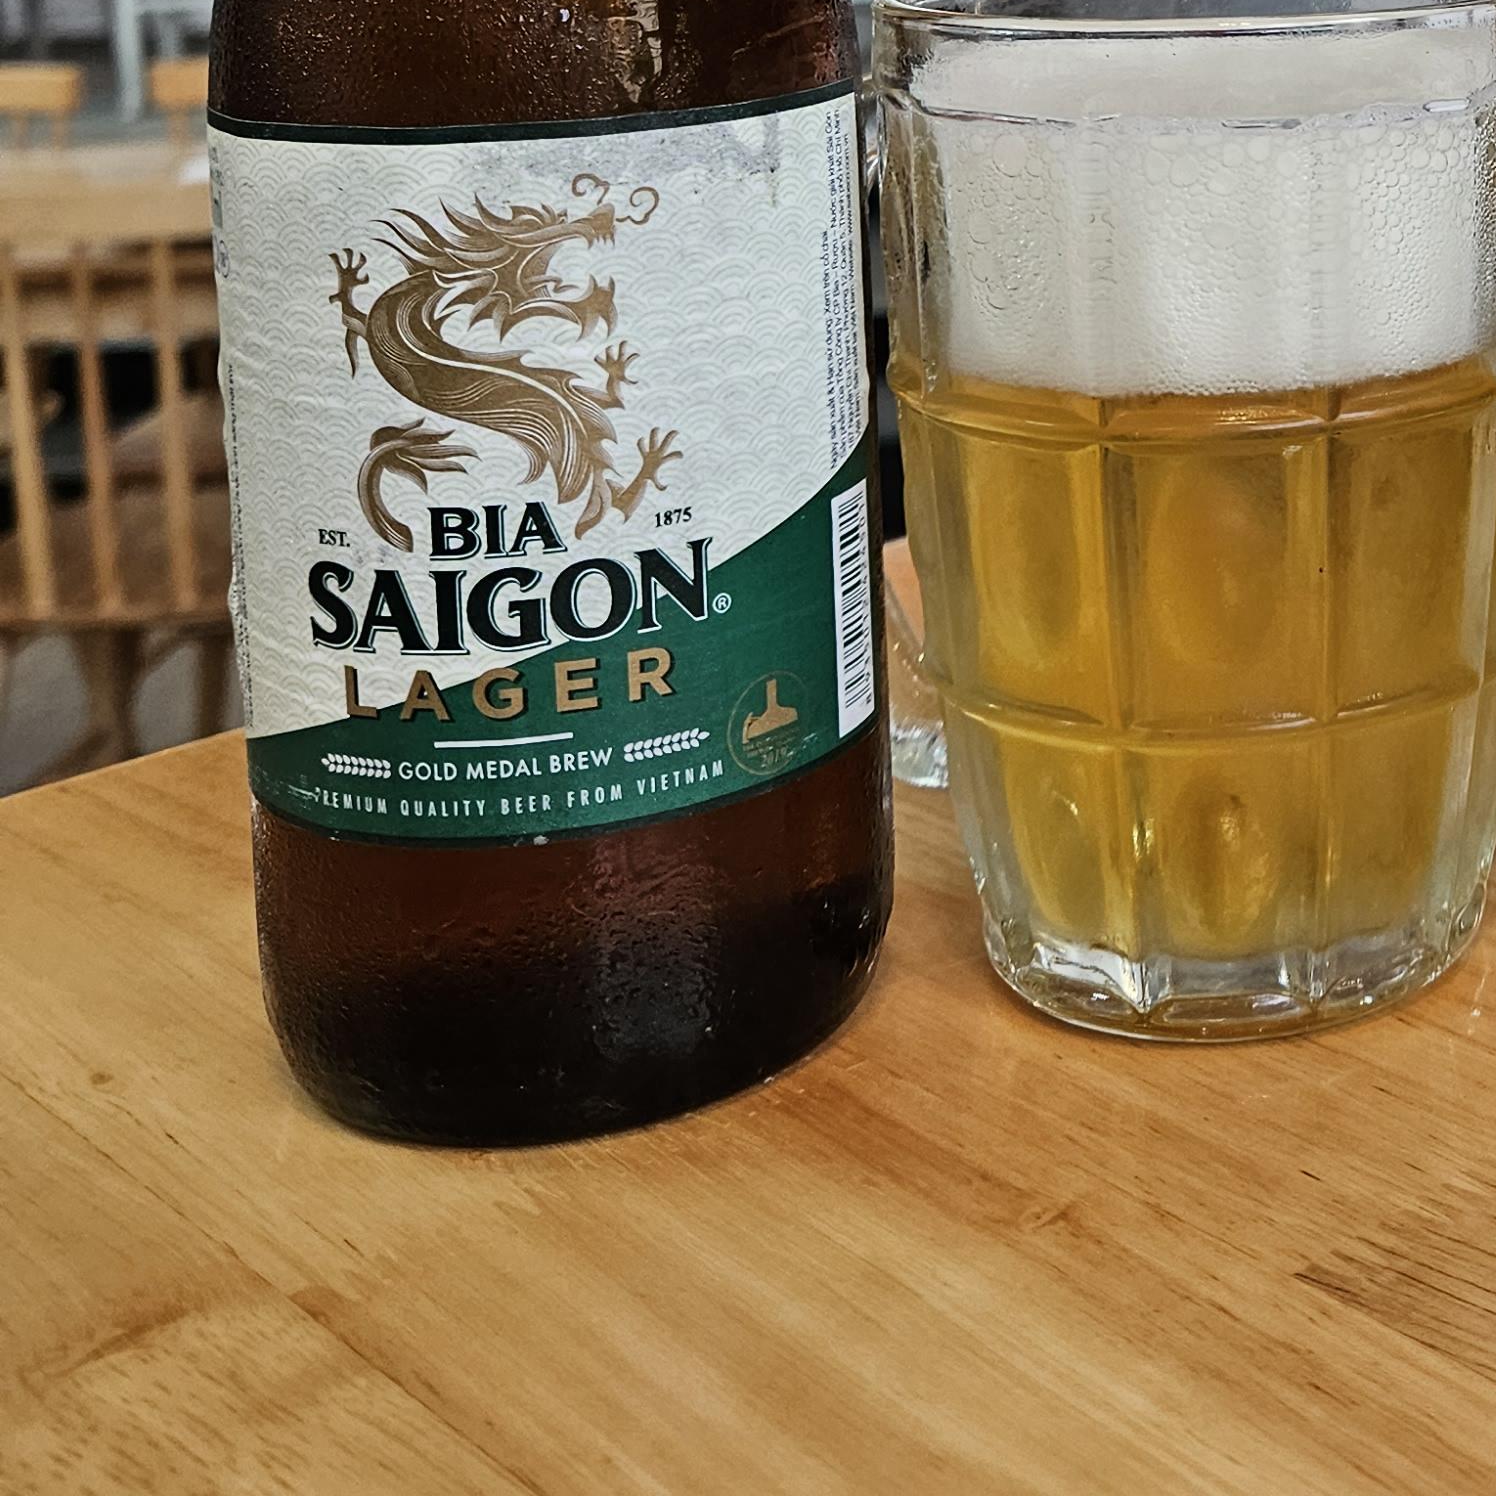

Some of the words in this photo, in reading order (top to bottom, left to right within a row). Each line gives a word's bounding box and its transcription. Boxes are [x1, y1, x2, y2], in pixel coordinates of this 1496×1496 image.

[318, 528, 351, 548] EST.
[427, 501, 568, 561] BIA
[654, 506, 693, 528] 1875
[308, 537, 714, 656] SAIGON
[344, 646, 678, 723] LAGER
[398, 760, 458, 782] GOLD
[465, 754, 542, 781] MEDAL
[549, 746, 613, 773] BREW
[400, 799, 487, 818] QUALITY
[500, 793, 553, 816] BEER
[566, 783, 623, 809] FROM
[636, 760, 725, 797] VIETNAM
